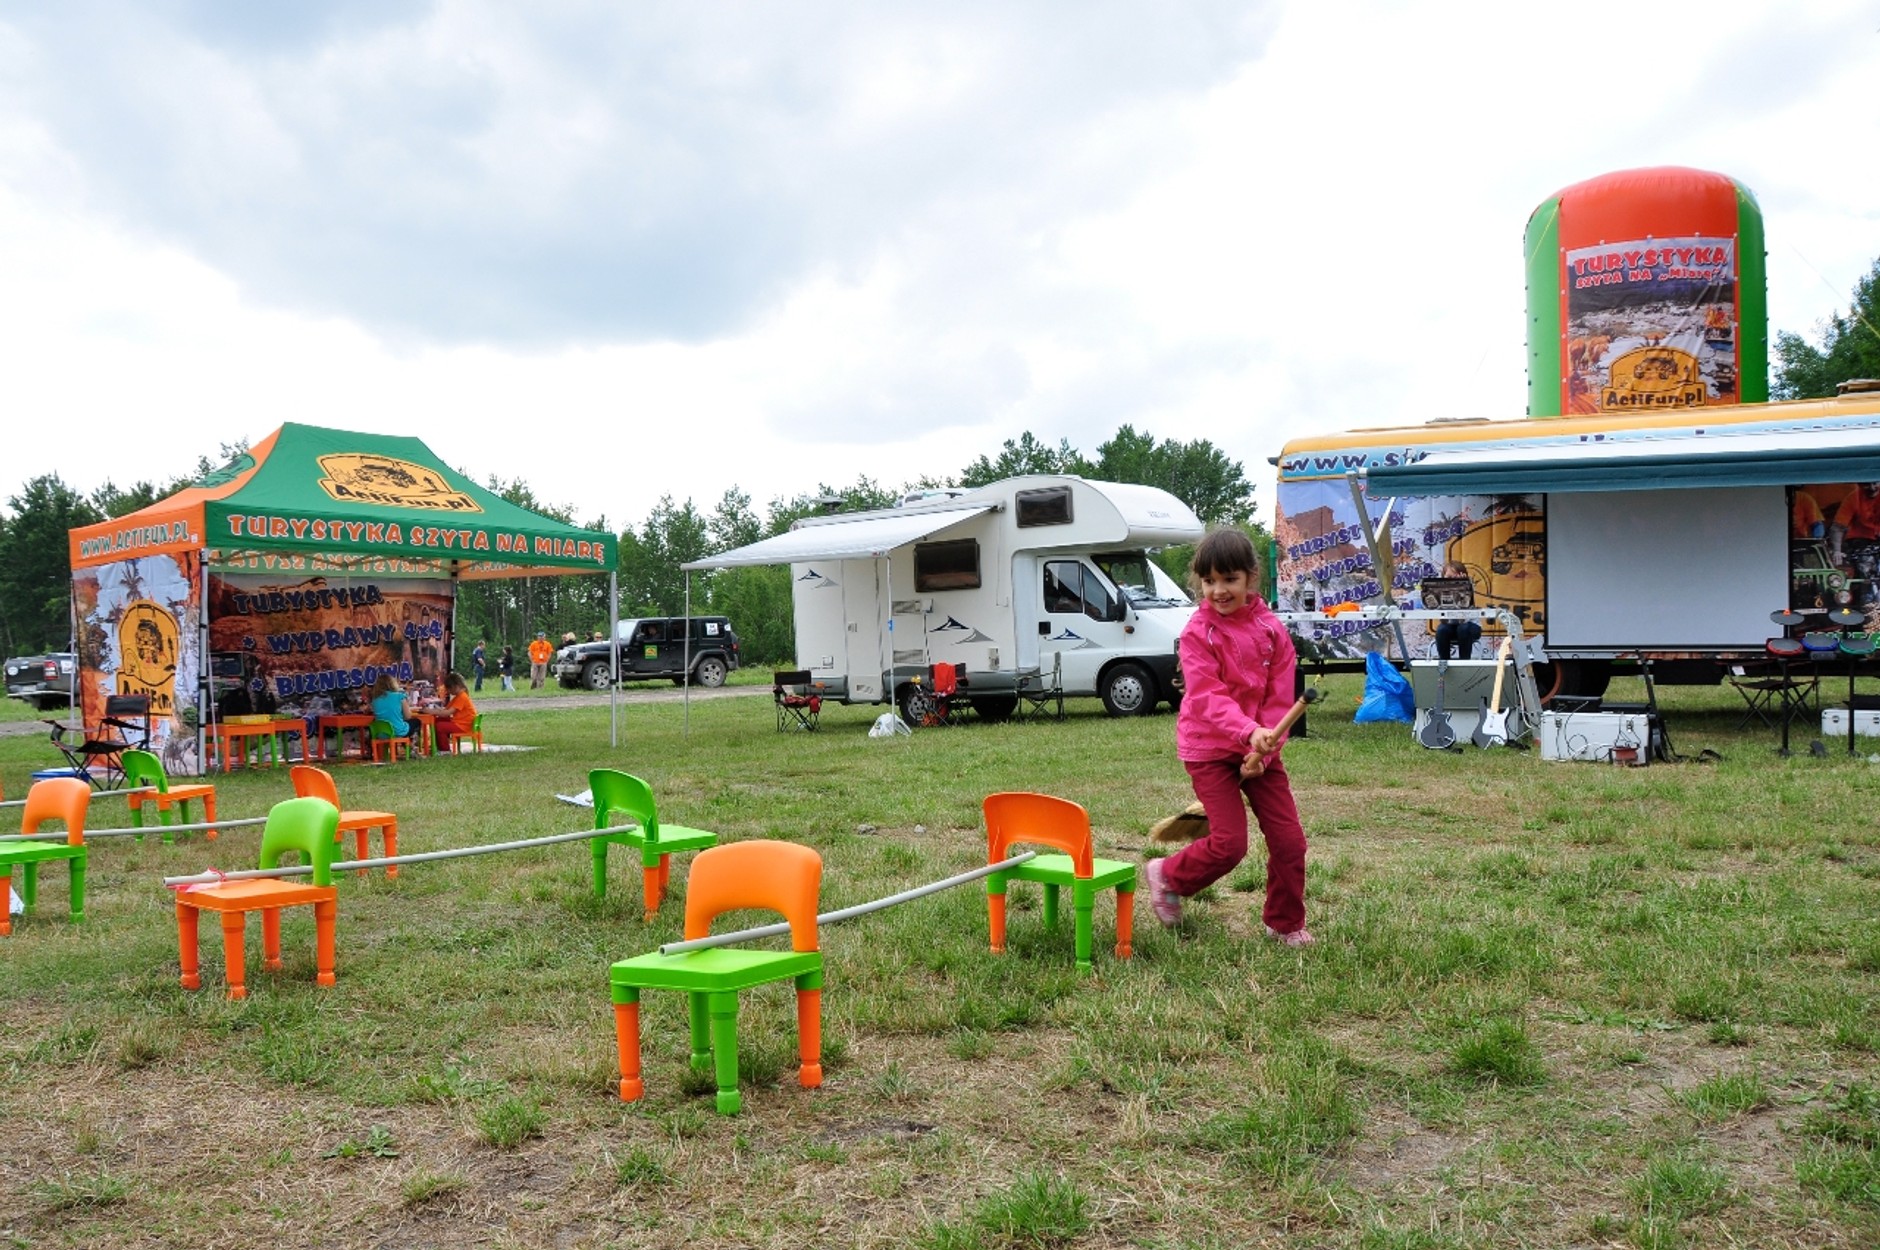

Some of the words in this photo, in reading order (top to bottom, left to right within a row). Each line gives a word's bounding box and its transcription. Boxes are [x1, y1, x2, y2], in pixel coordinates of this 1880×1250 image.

[1574, 246, 1728, 276] TURYSTYKA
[1575, 270, 1623, 289] SZYTA
[1628, 269, 1652, 282] NA
[80, 520, 189, 559] WWW.ACTIFUN.PL
[227, 514, 403, 545] TURYSTYKA
[410, 525, 490, 551] SZYTA
[496, 533, 529, 554] NA
[534, 536, 606, 566] MIARĘ
[1288, 511, 1404, 560] TURYSTA
[1311, 537, 1417, 582] WYPRY
[233, 584, 386, 615] TURYSTYKA
[1321, 562, 1439, 609] BIZNEOWA
[266, 622, 397, 655] WYPRAWY
[403, 619, 444, 642] 4x4
[275, 660, 415, 698] BIZNESOWA
